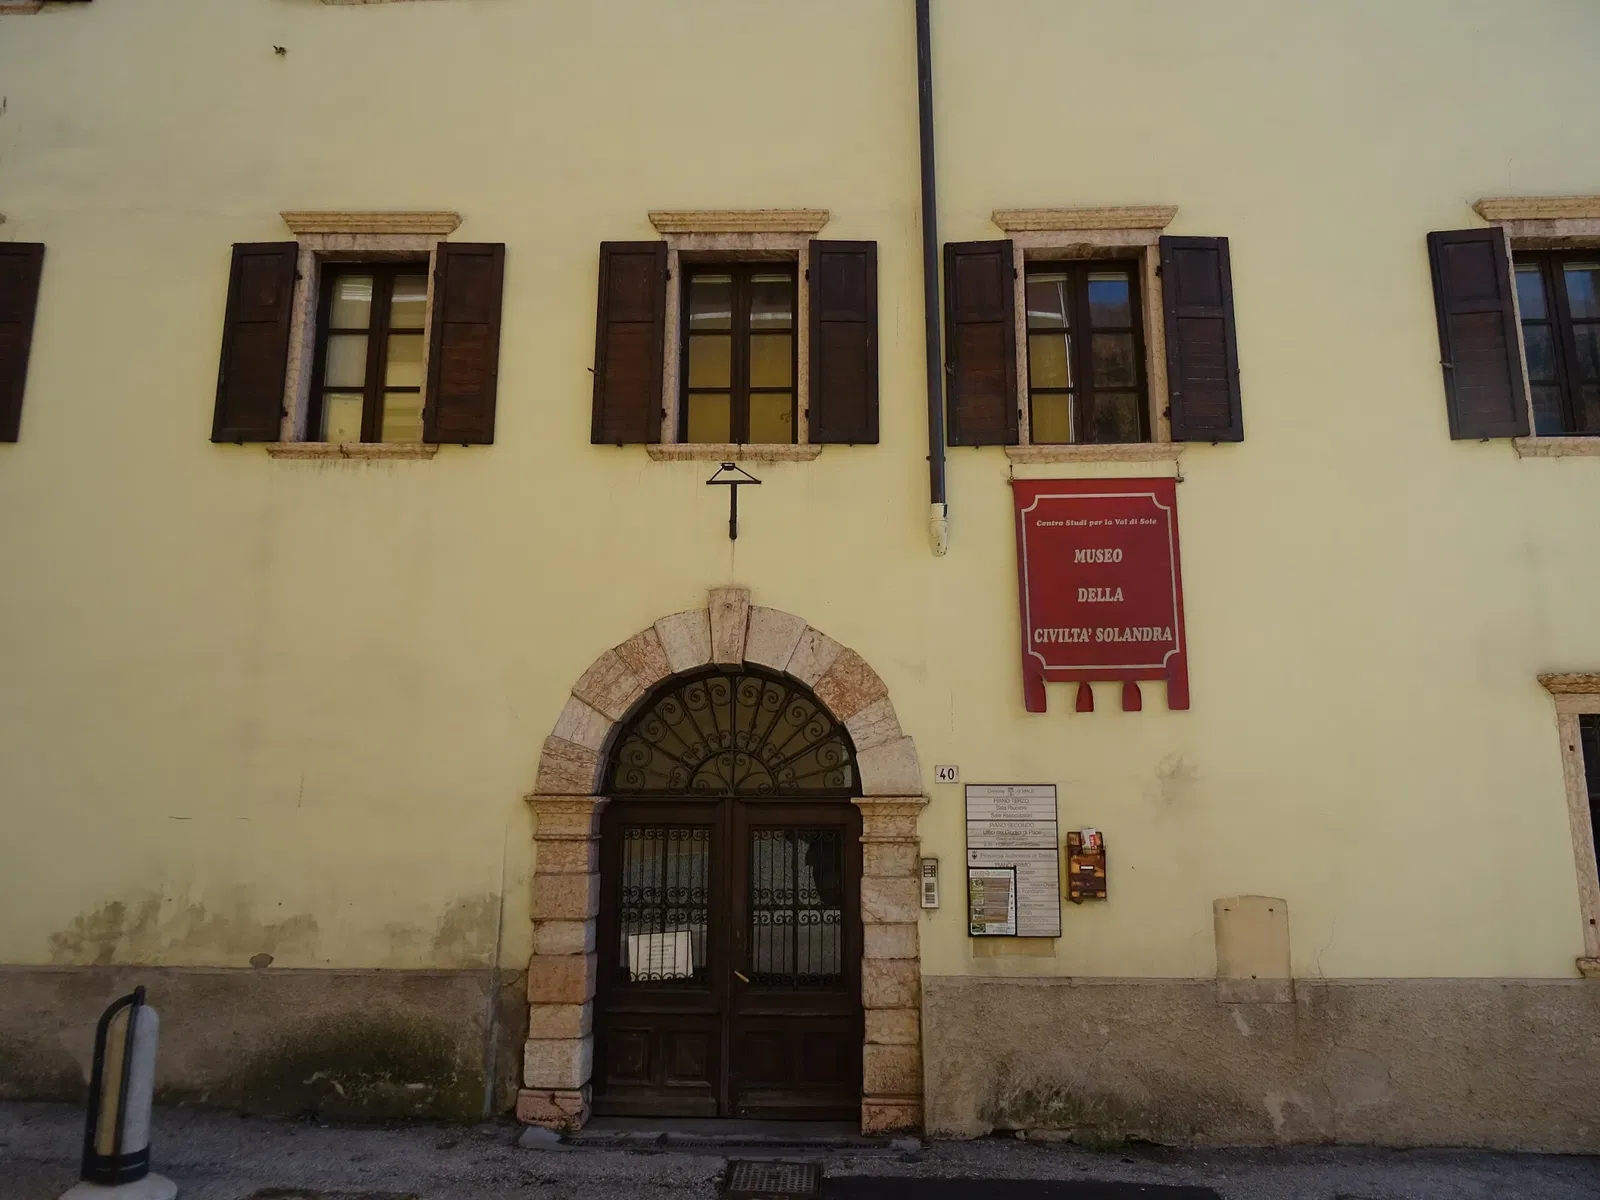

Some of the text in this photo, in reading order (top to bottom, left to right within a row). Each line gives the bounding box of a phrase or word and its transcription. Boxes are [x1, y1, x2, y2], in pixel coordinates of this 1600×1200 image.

[1036, 519, 1063, 527] Centro
[1089, 519, 1102, 527] per
[1104, 518, 1113, 526] la
[1074, 548, 1123, 563] MUSEO
[1077, 587, 1124, 602] DELLA
[1034, 626, 1172, 643] CIVILTA' SOLANDRA
[939, 767, 955, 780] 40
